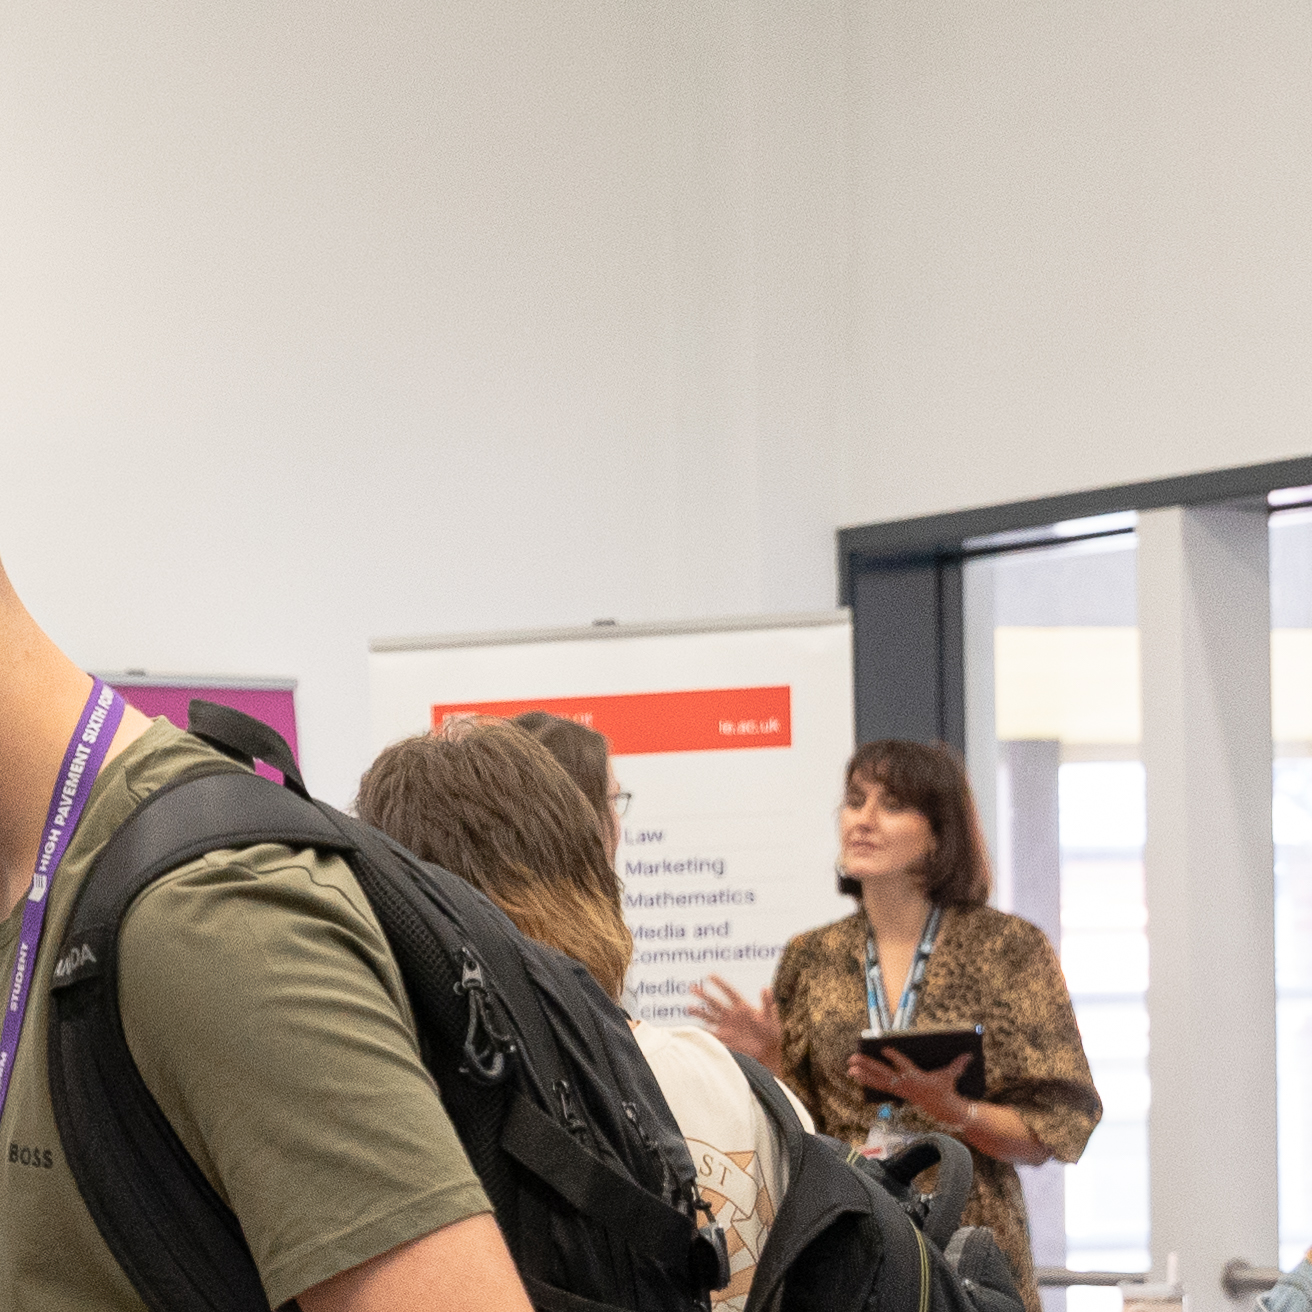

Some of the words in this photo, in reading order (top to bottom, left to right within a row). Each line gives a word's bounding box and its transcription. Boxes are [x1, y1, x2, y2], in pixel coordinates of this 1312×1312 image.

[38, 829, 62, 873] HIGH
[54, 742, 93, 828] PAVEMENT
[80, 702, 109, 745] SIXTH
[625, 830, 664, 845] Law
[626, 858, 726, 879] Marketing
[626, 889, 756, 908] Mathematics
[694, 921, 730, 939] and
[9, 941, 30, 1013] STUDENT
[8, 1142, 54, 1170] BOSS
